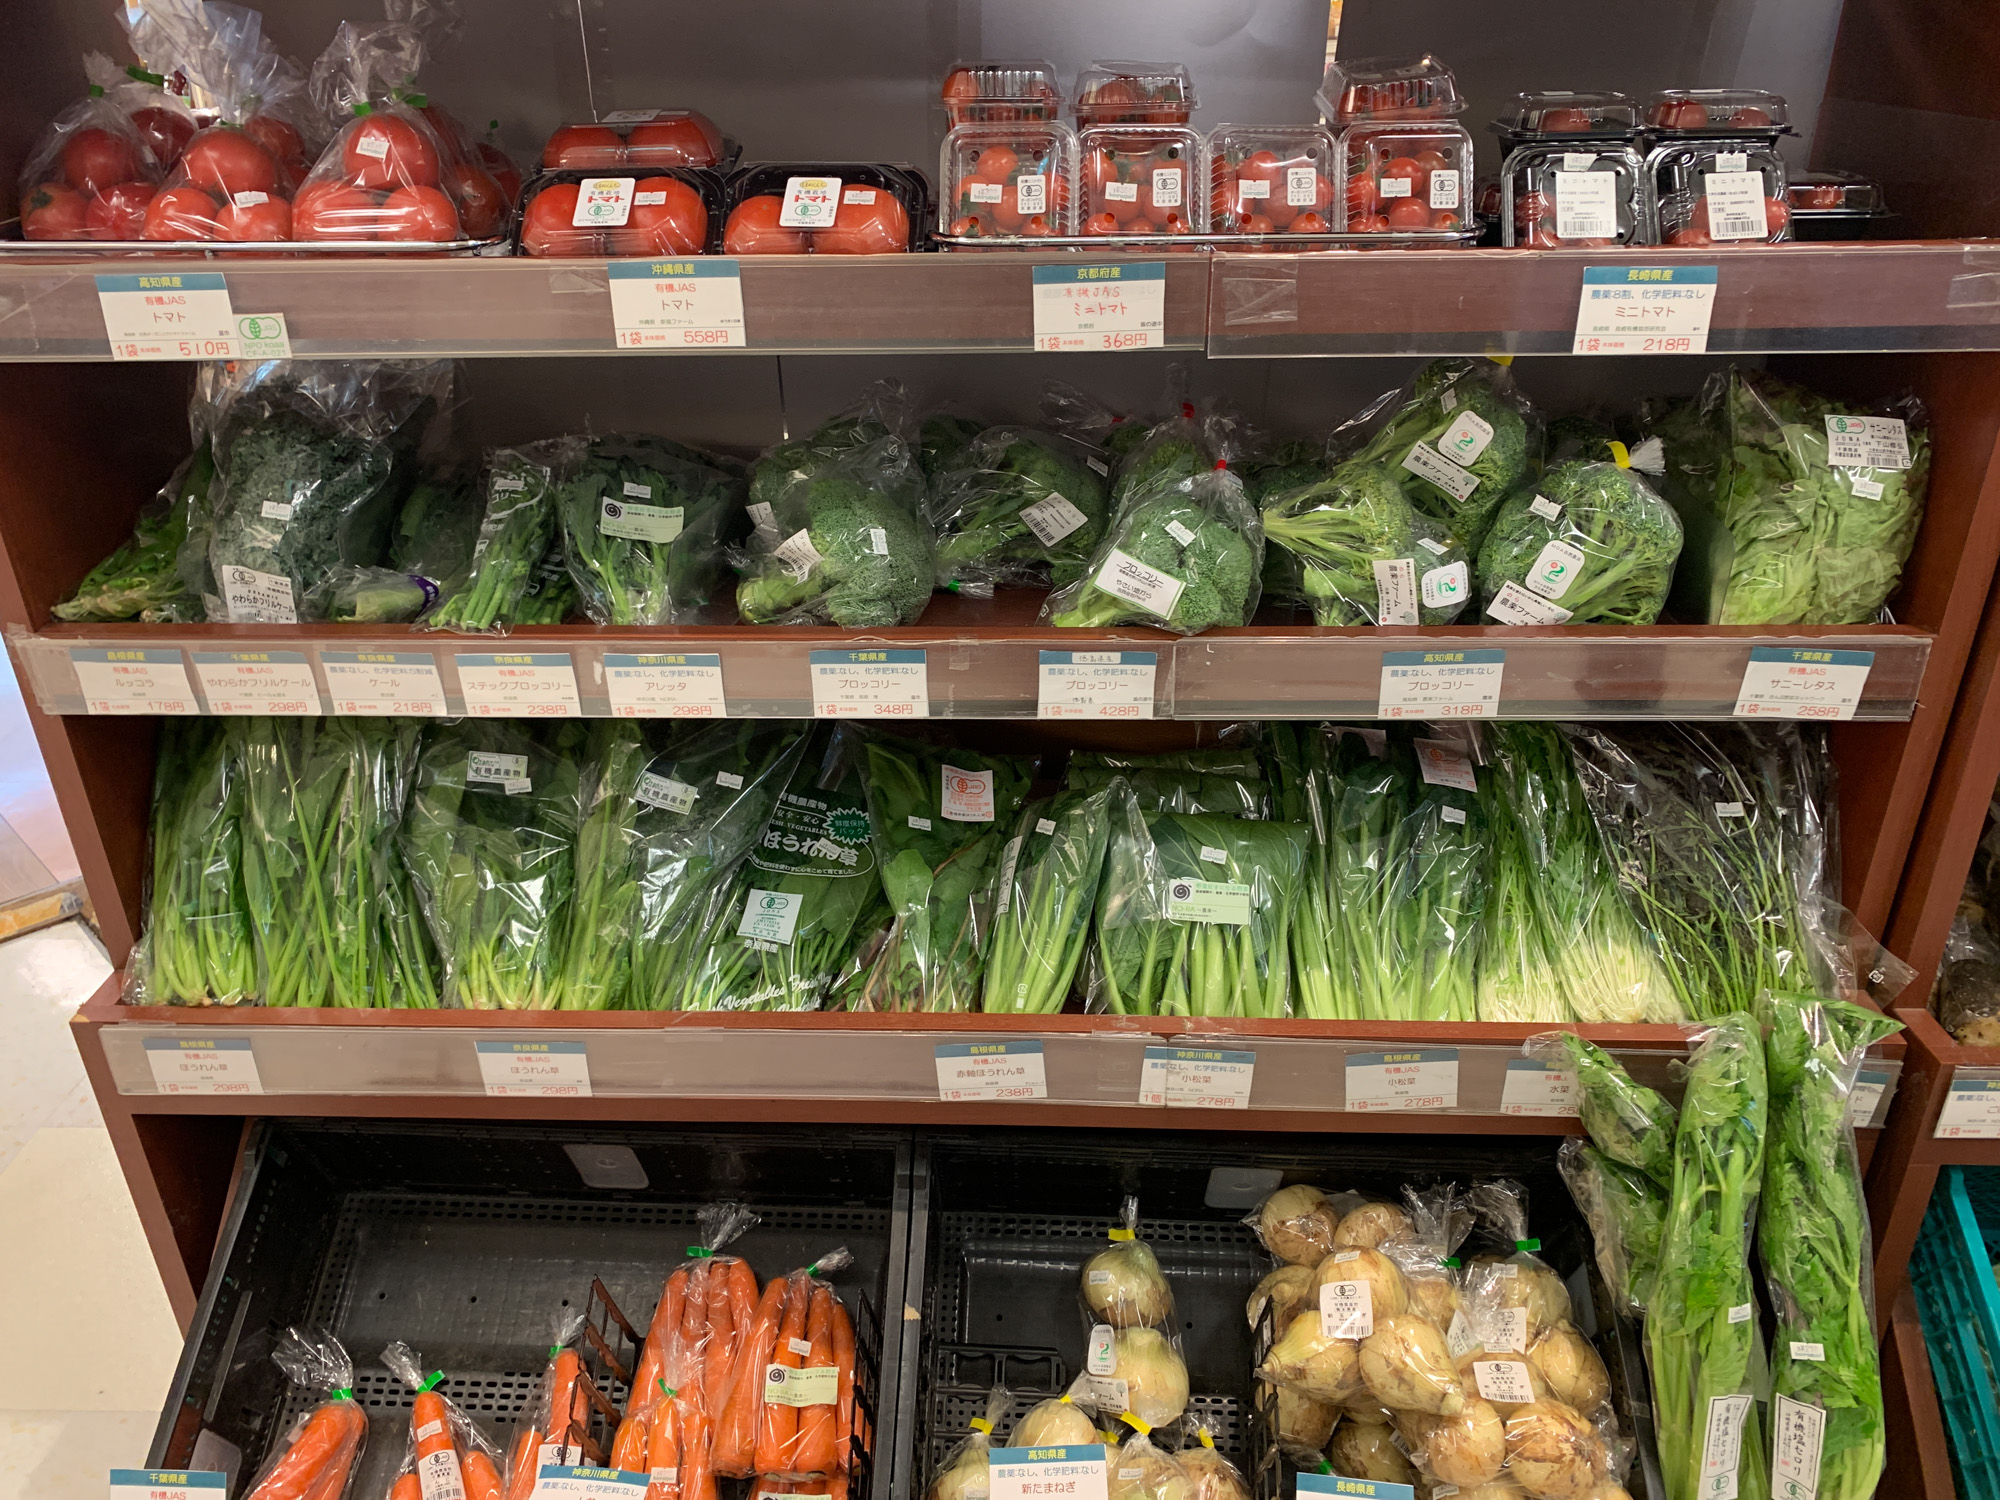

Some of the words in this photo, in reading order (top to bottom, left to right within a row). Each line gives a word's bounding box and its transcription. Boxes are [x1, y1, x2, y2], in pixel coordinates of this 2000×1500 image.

[794, 195, 832, 203] トマト
[652, 263, 695, 275] 沖縄県産
[1077, 267, 1121, 279] 京都府産
[1628, 269, 1674, 281] 長崎県産
[138, 277, 183, 288] 高知県産
[656, 283, 696, 293] 有機JAS
[145, 296, 186, 306] 有機JAS
[662, 299, 694, 311] トマト
[1074, 302, 1128, 316] ミニトマト
[1615, 306, 1676, 318] ミニトマト
[153, 312, 186, 324] トマト
[620, 332, 642, 345] 1袋
[684, 330, 728, 343] 558円
[1039, 337, 1060, 349] 1袋
[1103, 333, 1147, 348] 368円
[116, 344, 139, 357] 1袋
[179, 342, 230, 355] 510円
[1578, 338, 1600, 351] 1袋
[1643, 338, 1690, 351] 218円
[1122, 561, 1163, 585] ブロッコリー
[357, 654, 395, 663] 奈良県産
[494, 656, 533, 665] 奈良県産
[637, 656, 686, 664] 神奈川県産
[849, 653, 887, 662] 千葉県産
[1424, 653, 1464, 662] 高知県産
[1792, 652, 1833, 662] 千葉県産
[112, 666, 148, 675] 有機JAS
[498, 669, 535, 677] 有機JAS
[1788, 667, 1827, 676] 有機JAS
[115, 678, 154, 688] ルッコラ
[206, 678, 311, 688] やわらかフリルケール
[369, 678, 400, 688] ケール
[467, 682, 572, 691] ステックブロッコリー
[645, 682, 686, 691] アレッタ
[838, 680, 901, 689] ブロッコリー
[1066, 681, 1128, 690] ブロッコリー
[1408, 681, 1474, 691] ブロッコリー
[1771, 680, 1835, 691] サニーレタス
[147, 701, 185, 712] 178円
[268, 702, 307, 712] 298円
[393, 702, 432, 713] 218円
[527, 705, 567, 715] 238円
[616, 706, 635, 716] 1袋
[672, 706, 712, 716] 298円
[818, 704, 837, 715] 1袋
[874, 704, 913, 715] 348円
[1042, 706, 1062, 716] 1袋
[1099, 706, 1139, 717] 428円
[1382, 707, 1403, 717] 1袋
[1441, 705, 1483, 716] 318円
[1739, 704, 1760, 714] 1袋
[1797, 706, 1840, 717] 258円
[779, 793, 828, 811] 有機農産物
[787, 823, 828, 835] VEGETABLES
[970, 1045, 1006, 1054] 島根県産
[1177, 1051, 1222, 1060] 神奈川県産
[957, 1067, 1025, 1078] 赤軸ほうれん草
[1385, 1066, 1420, 1074] 有機JAS
[1182, 1074, 1211, 1084] 小松菜
[1388, 1078, 1416, 1086] 小松菜
[212, 1084, 250, 1092] 298円
[541, 1086, 578, 1095] 298円
[996, 1088, 1033, 1098] 238円
[1549, 1085, 1569, 1093] 水菜
[1197, 1096, 1235, 1107] 278円
[1404, 1097, 1443, 1107] 278円
[1028, 1449, 1067, 1460] 高知県産
[572, 1468, 619, 1480] 神奈川県産
[149, 1474, 188, 1485] 千葉県産
[1022, 1481, 1076, 1495] 新たまねぎ
[1336, 1481, 1375, 1496] 長崎県産
[150, 1490, 186, 1500] 有機JAS
